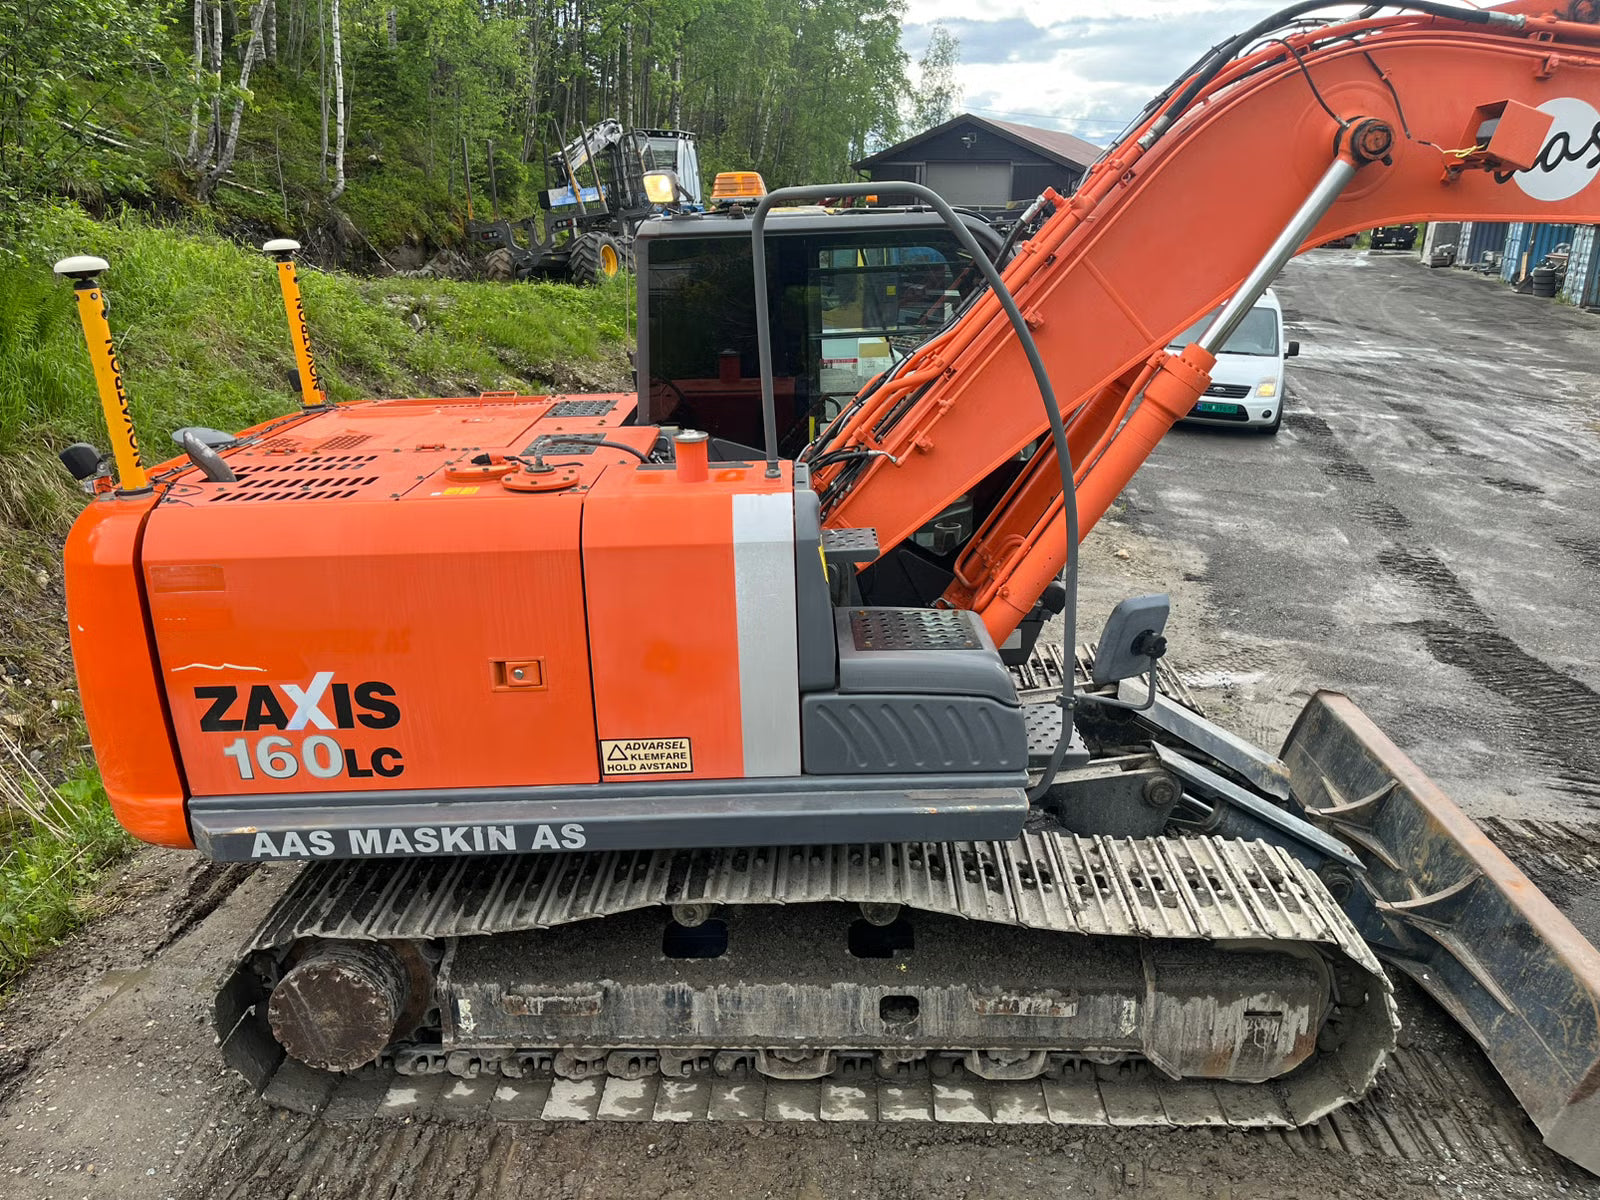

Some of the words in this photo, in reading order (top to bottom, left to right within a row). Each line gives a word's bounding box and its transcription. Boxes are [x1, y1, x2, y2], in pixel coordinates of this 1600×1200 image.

[295, 298, 321, 391] NOVATRON
[105, 339, 142, 468] NOVATRON
[194, 671, 401, 732] ZAXIS
[624, 741, 686, 751] ADVARSEL
[630, 752, 687, 761] KLEMFARE
[607, 763, 637, 772] HOLD
[639, 761, 688, 771] AVSTAND
[251, 831, 335, 858] AAS
[348, 825, 516, 855] MASKIN
[531, 823, 587, 851] AS
